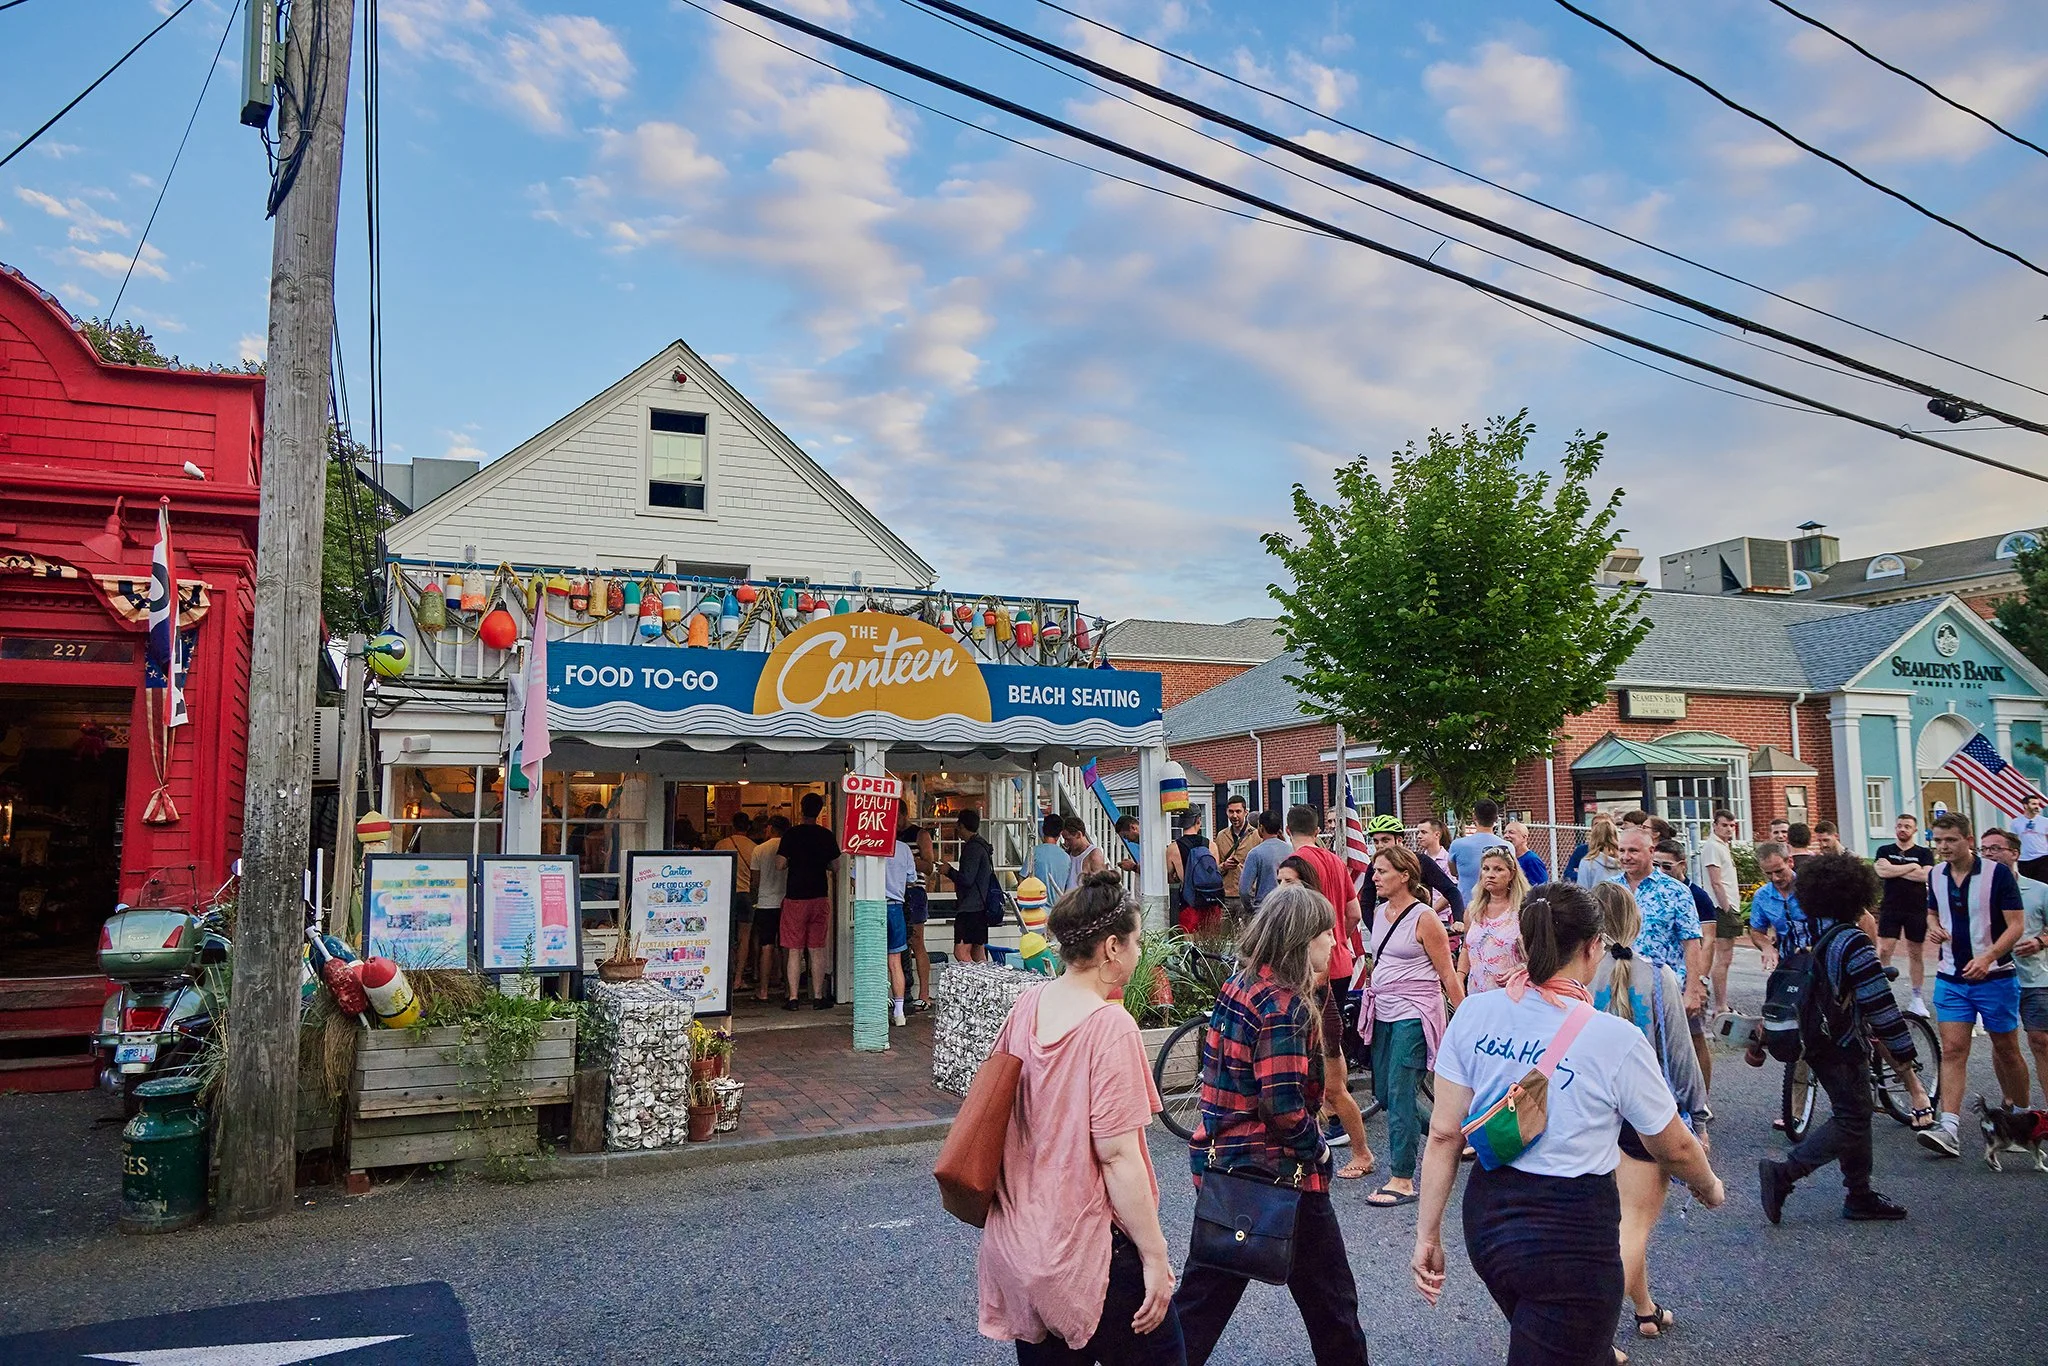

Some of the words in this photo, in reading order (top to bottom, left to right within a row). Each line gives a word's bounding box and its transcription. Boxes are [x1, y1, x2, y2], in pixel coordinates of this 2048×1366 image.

[850, 625, 878, 640] THE
[53, 643, 87, 657] 227
[565, 664, 634, 687] FOOD
[641, 667, 718, 692] TO-GO
[776, 627, 959, 711] Canteen
[1891, 656, 1961, 680] SEAMEN'S
[1962, 660, 2006, 682] BANK
[1912, 679, 1953, 688] MEMBER
[1008, 684, 1066, 706] BEACH
[1071, 687, 1141, 709] SEATING
[1665, 694, 1684, 704] BANK
[854, 794, 892, 811] BEACH
[858, 810, 888, 832] BAR
[848, 834, 885, 853] Open
[661, 864, 693, 879] Canteen
[652, 881, 666, 889] CAPE
[678, 880, 704, 888] CLASSICS
[1474, 1033, 1515, 1060] Keith
